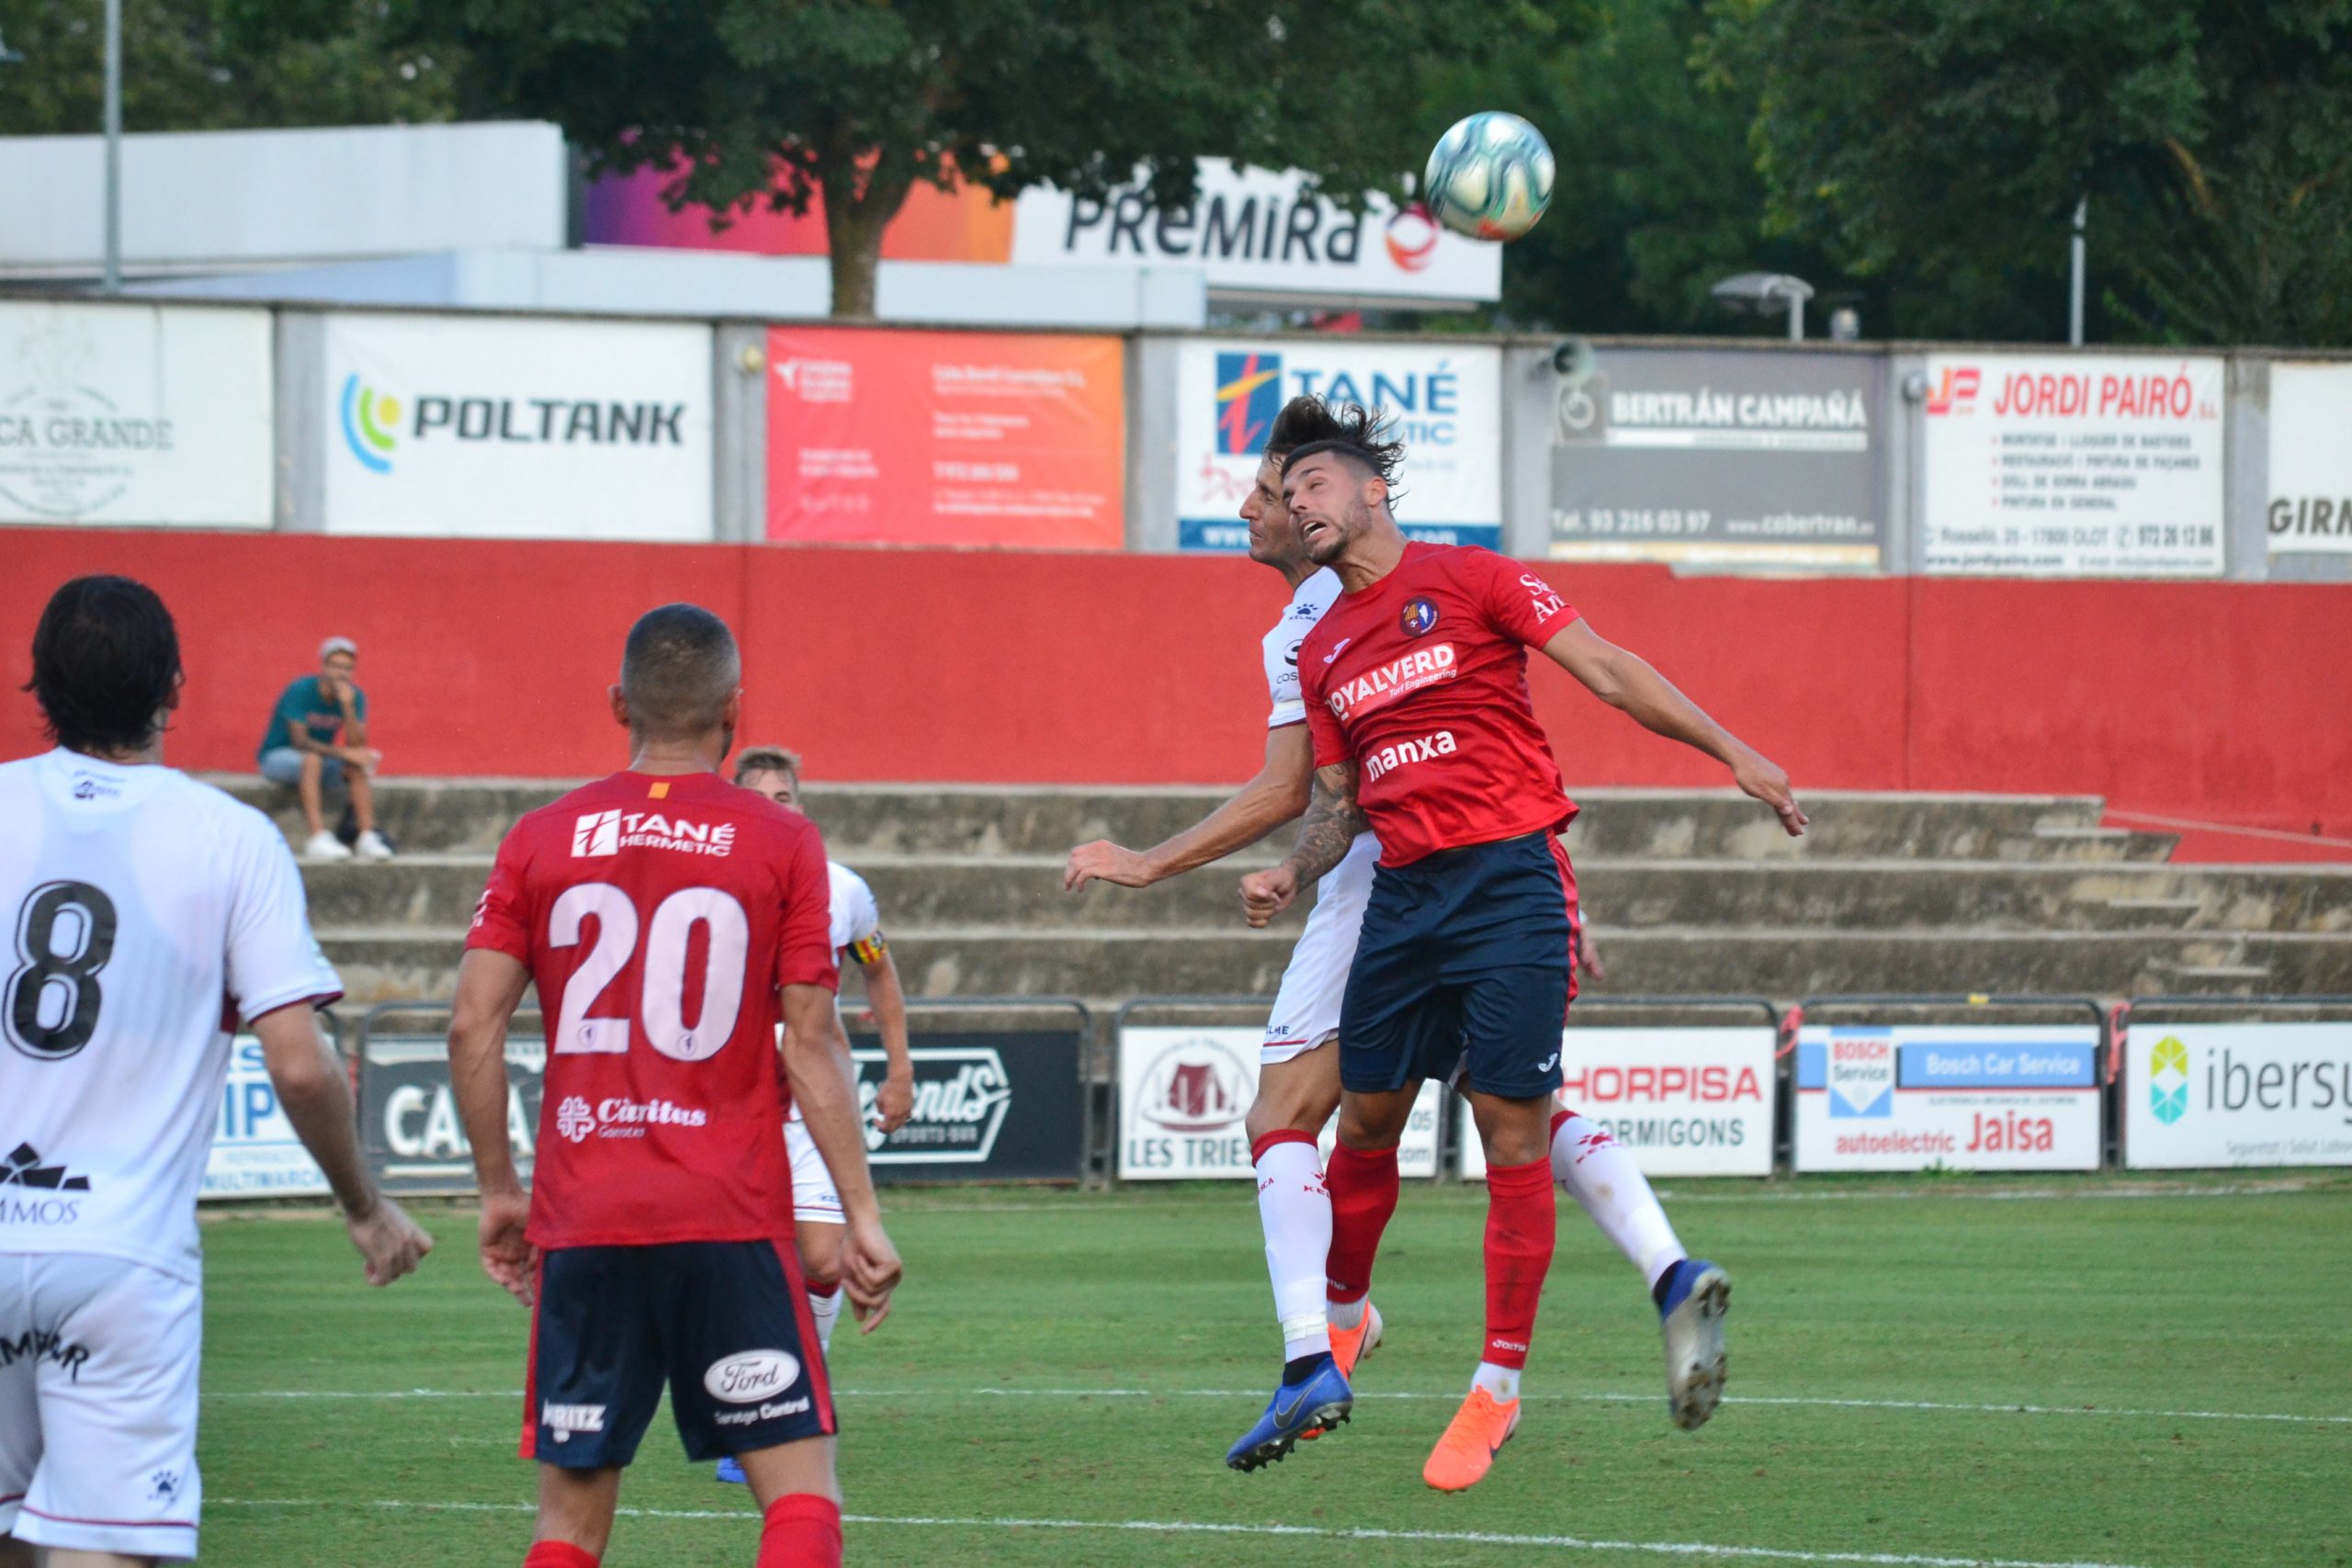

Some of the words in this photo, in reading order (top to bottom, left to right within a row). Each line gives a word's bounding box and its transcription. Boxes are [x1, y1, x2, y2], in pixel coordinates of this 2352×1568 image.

[1290, 360, 1457, 413] TANÉ
[1995, 373, 2089, 417] JORDI
[2099, 363, 2192, 418] PAIRÓ
[413, 396, 686, 446] POLTANK
[1611, 386, 1734, 425] BERTRÁN
[46, 416, 174, 450] GRANDE
[1289, 615, 1317, 623] KELME
[1276, 671, 1298, 685] COS
[1388, 682, 1406, 698] Turf
[1405, 669, 1457, 690] Engineering
[1366, 730, 1457, 783] manxa
[622, 812, 736, 845] TANÉ
[2, 880, 118, 1061] 8
[548, 882, 749, 1062] 20
[1833, 1042, 1888, 1061] BOSCH
[1926, 1053, 1981, 1076] Bosch
[1984, 1054, 2015, 1076] Car
[2018, 1054, 2081, 1076] Service
[1558, 1066, 1762, 1102] HORPISA
[1833, 1065, 1887, 1082] Service
[1598, 1117, 1744, 1147] ORMIGONS
[1966, 1111, 2053, 1154] Jaisa
[1128, 1137, 1172, 1168] LES
[1304, 1185, 1330, 1199] KEL
[721, 1359, 779, 1393] Ford
[760, 1395, 809, 1420] Central
